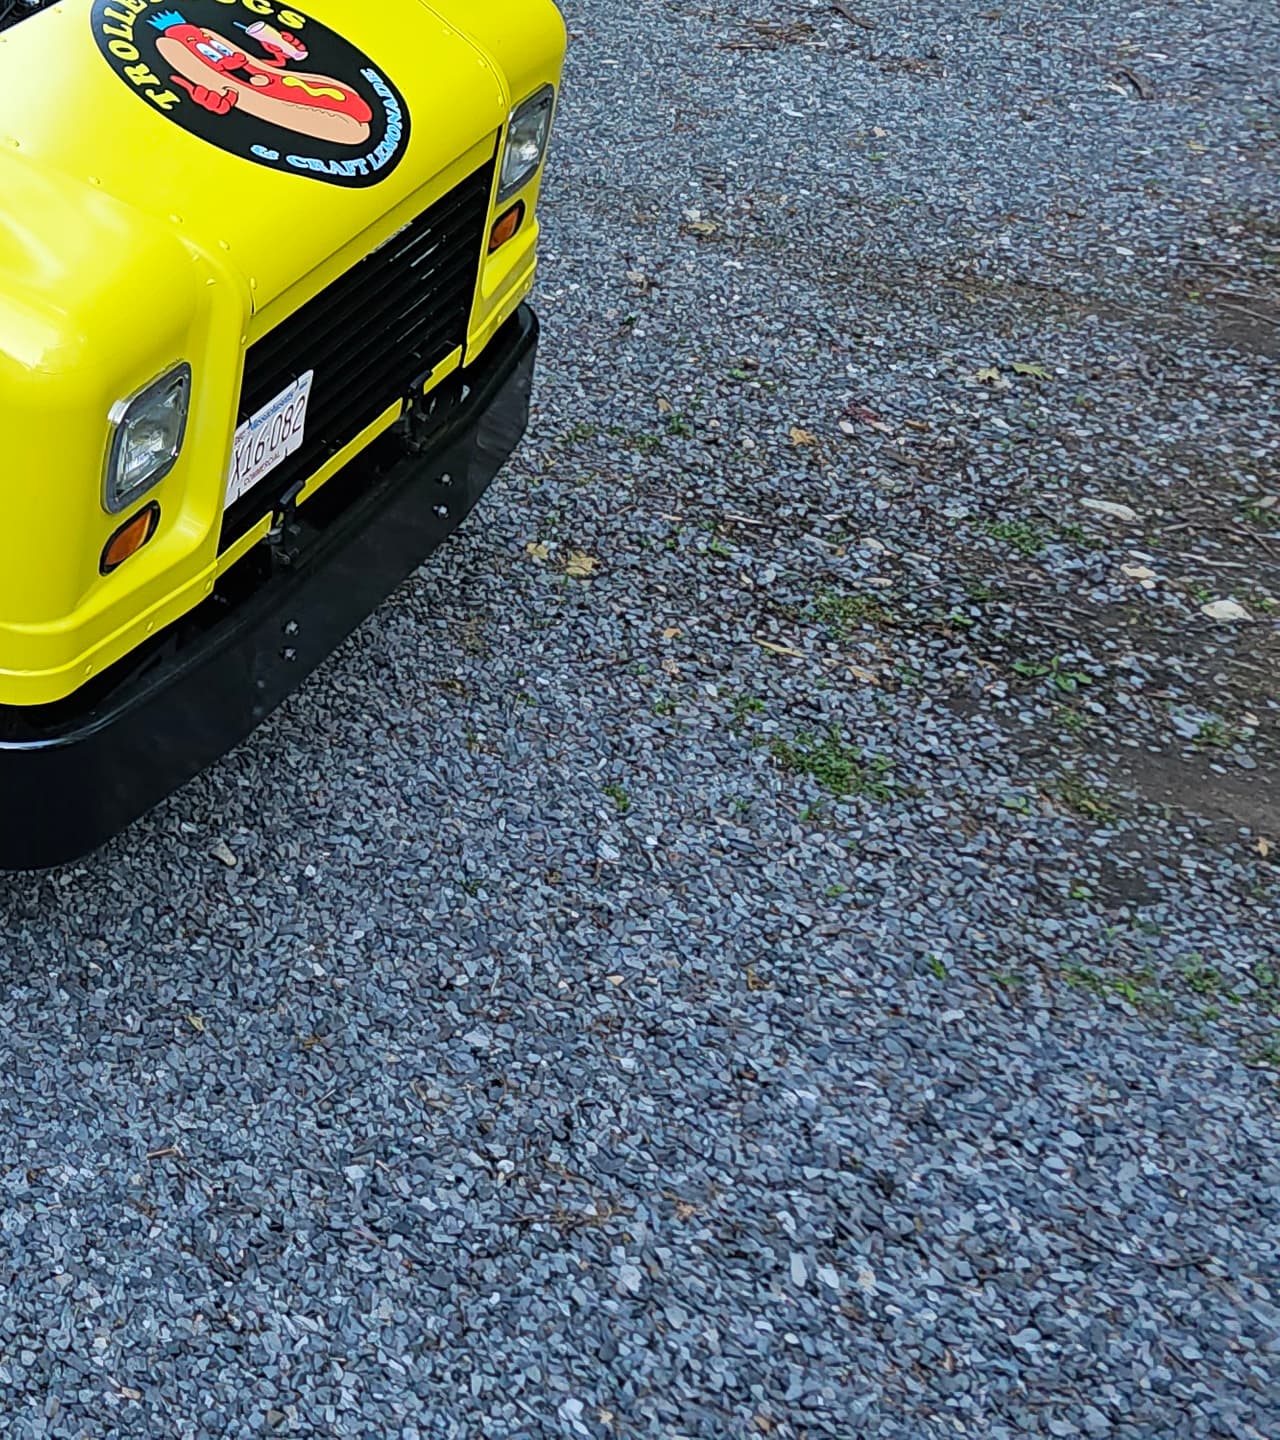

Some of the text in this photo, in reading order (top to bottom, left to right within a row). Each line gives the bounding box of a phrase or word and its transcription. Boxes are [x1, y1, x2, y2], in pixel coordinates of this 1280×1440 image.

[250, 67, 403, 177] & CRAFT LEMONADE
